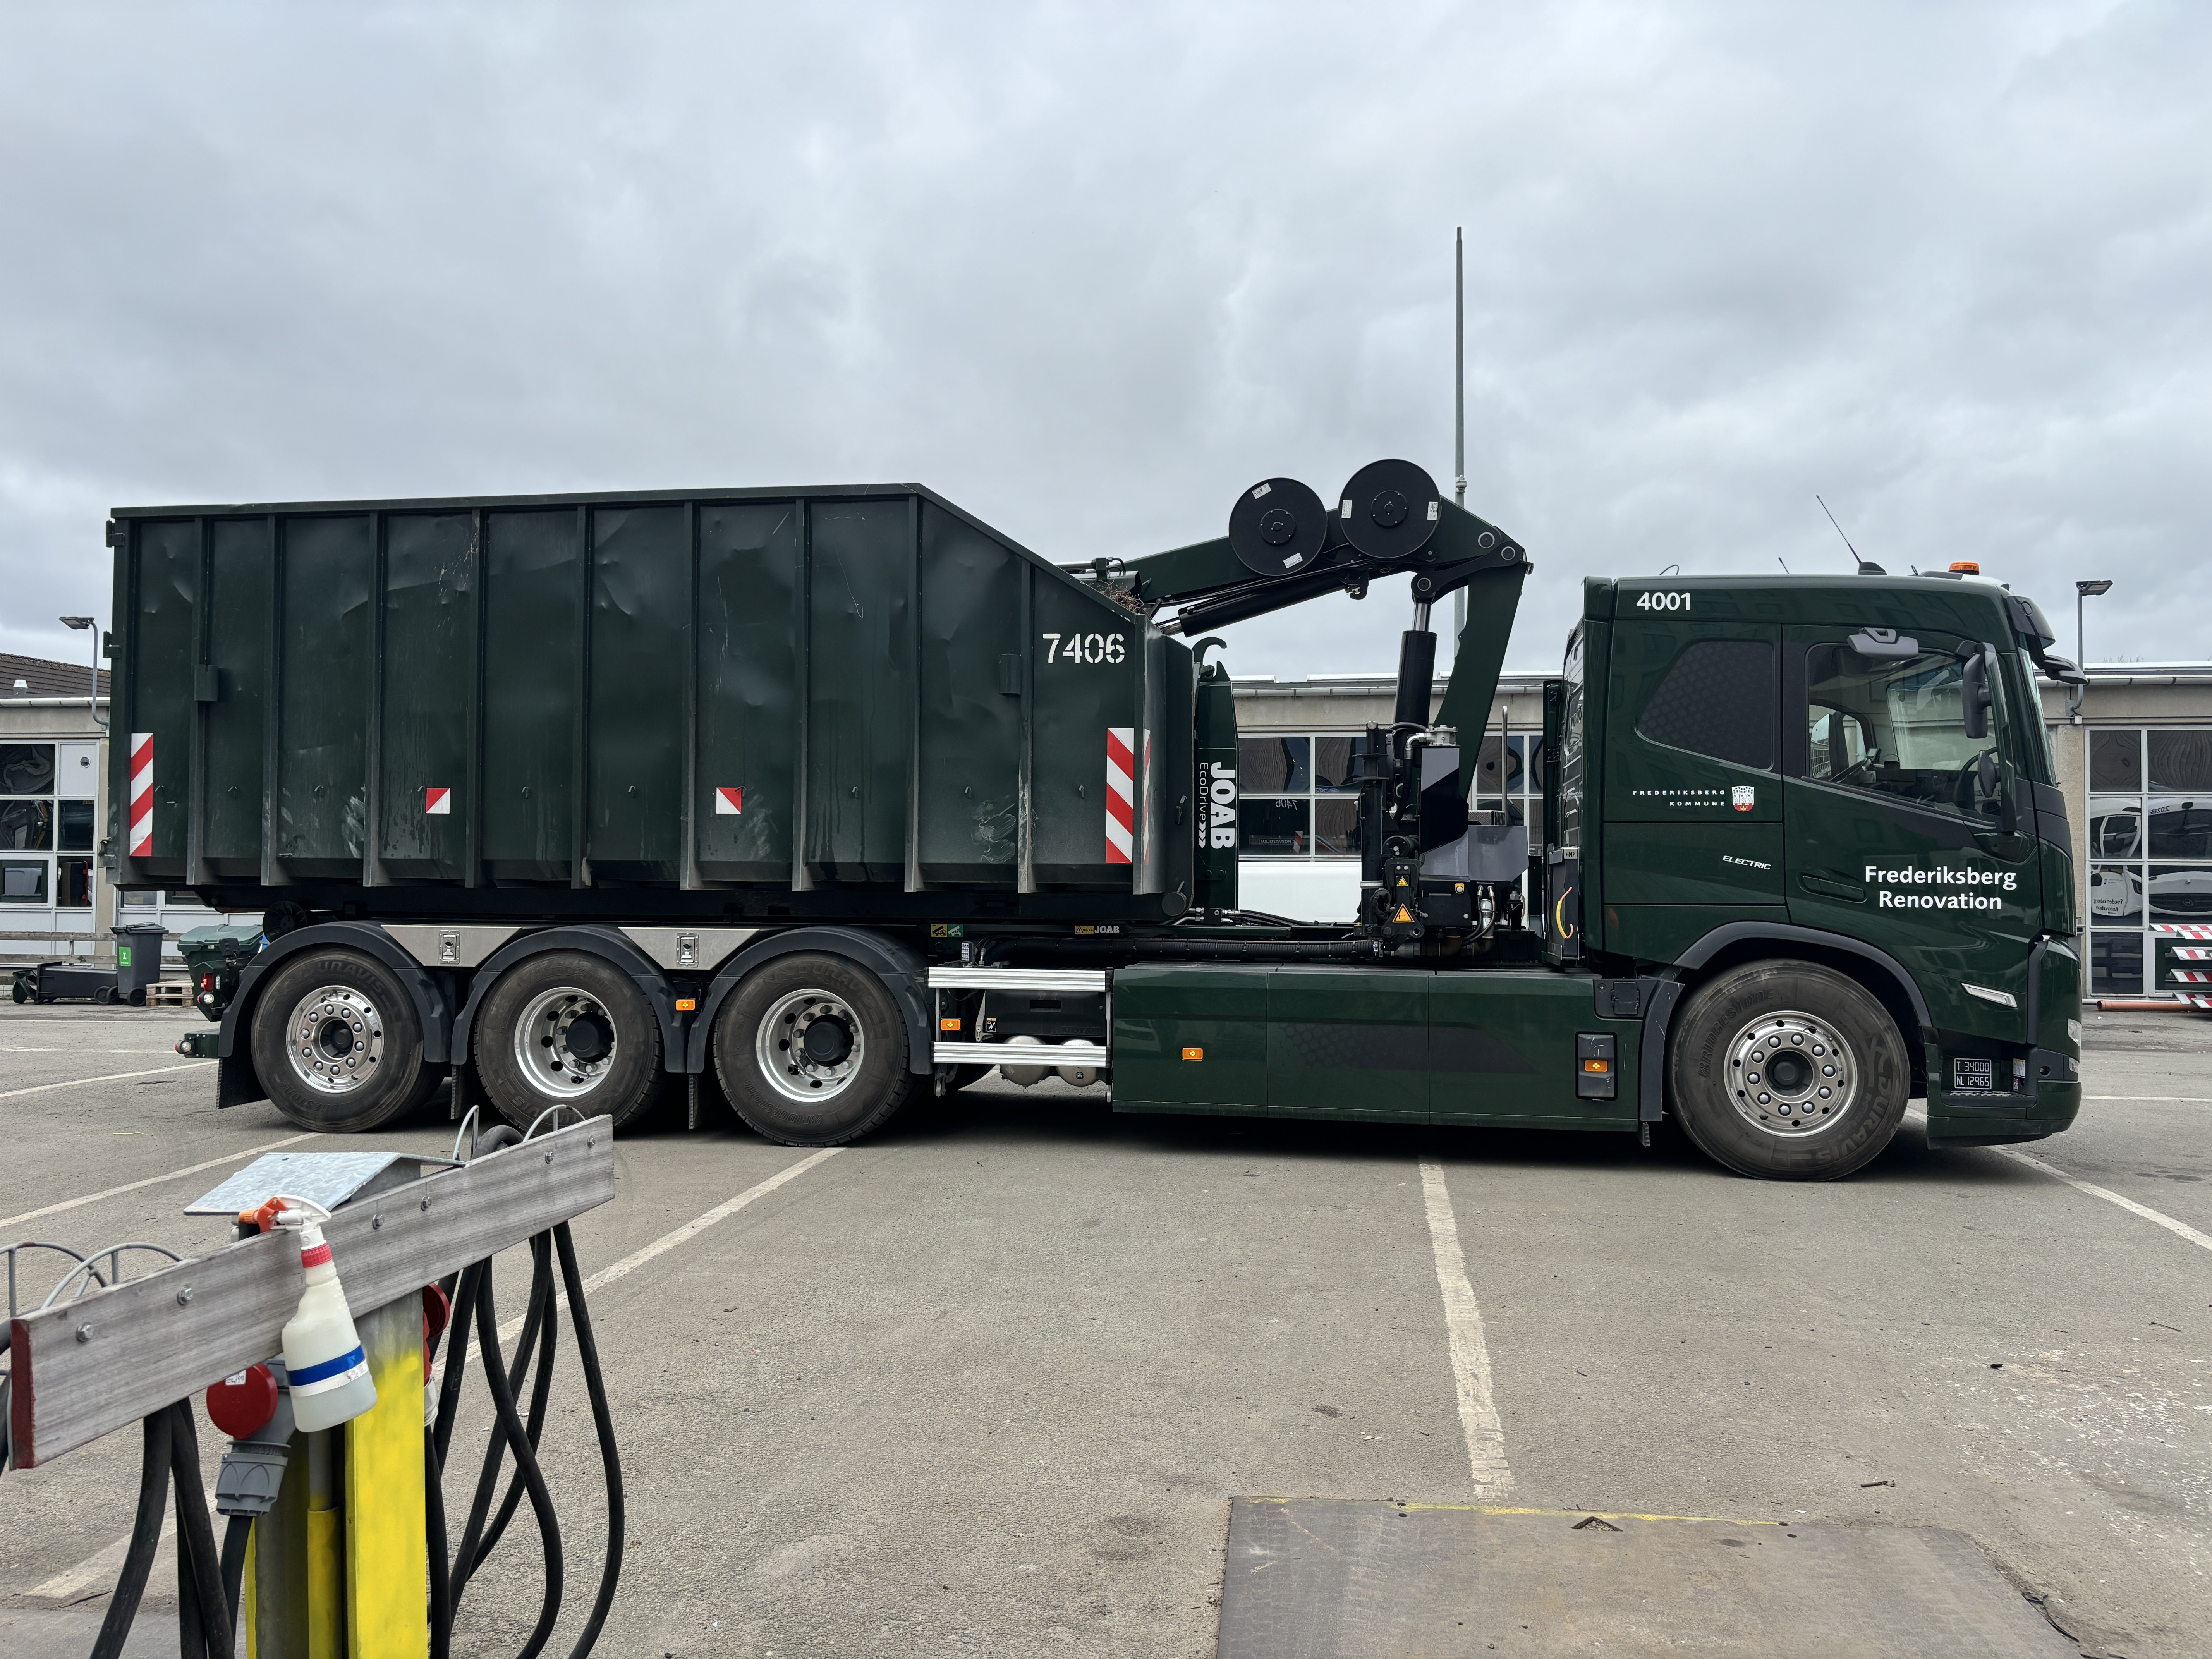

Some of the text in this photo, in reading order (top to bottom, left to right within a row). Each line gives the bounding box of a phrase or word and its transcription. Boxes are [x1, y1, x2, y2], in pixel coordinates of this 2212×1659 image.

[1637, 592, 1690, 610] 4001
[1042, 633, 1125, 663] 7406
[1199, 763, 1208, 820] EcoDrive
[1211, 762, 1236, 849] JOAB
[1722, 855, 1772, 870] ELECTRIC
[1865, 866, 2017, 890] Frederiksberg
[1879, 891, 2001, 910] Renovation
[1698, 988, 1774, 1079] BRIDGESTONE
[1956, 1061, 1989, 1072] T 34000
[1957, 1076, 1989, 1086] NL 12965
[743, 1079, 822, 1125] BRIDGESTONE
[1815, 1076, 1891, 1162] DURAVIS
